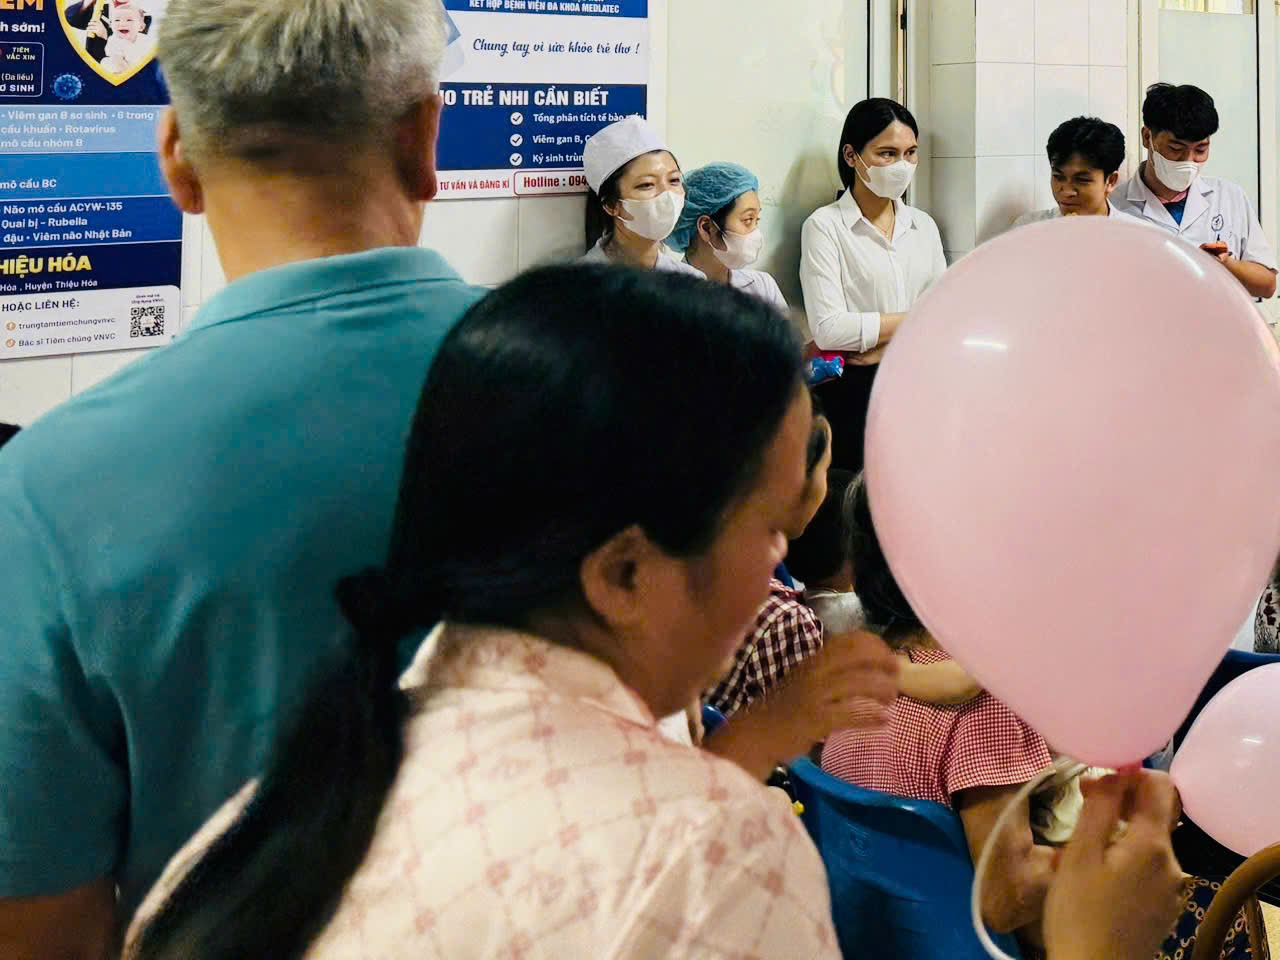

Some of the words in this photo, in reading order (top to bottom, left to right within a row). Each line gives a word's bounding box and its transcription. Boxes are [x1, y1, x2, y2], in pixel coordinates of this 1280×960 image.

[560, 2, 581, 12] KHOA
[582, 2, 620, 14] MEDLATEC
[11, 22, 46, 33] sớm!
[473, 38, 508, 57] Chung
[512, 40, 530, 58] tay
[533, 41, 545, 53] vì
[9, 84, 35, 92] SINH
[462, 85, 493, 106] TRẺ
[499, 90, 529, 106] NHI
[534, 85, 570, 106] CẦN
[574, 85, 609, 106] BIẾT
[38, 112, 58, 122] gan
[556, 113, 579, 124] phân
[581, 112, 597, 123] tích
[65, 124, 116, 134] Rotavirus
[532, 135, 555, 144] Viêm
[556, 136, 573, 145] gan
[532, 153, 544, 164] Ký
[545, 153, 564, 163] sinh
[565, 153, 584, 162] trùn
[42, 178, 57, 188] BC
[524, 176, 560, 188] Hotline
[569, 175, 588, 186] 094
[27, 203, 45, 214] mô
[69, 201, 123, 212] ACYW-135
[48, 217, 88, 228] Rubella
[32, 231, 60, 242] Viêm
[48, 252, 92, 274] HÓA
[94, 332, 116, 341] VNVC
